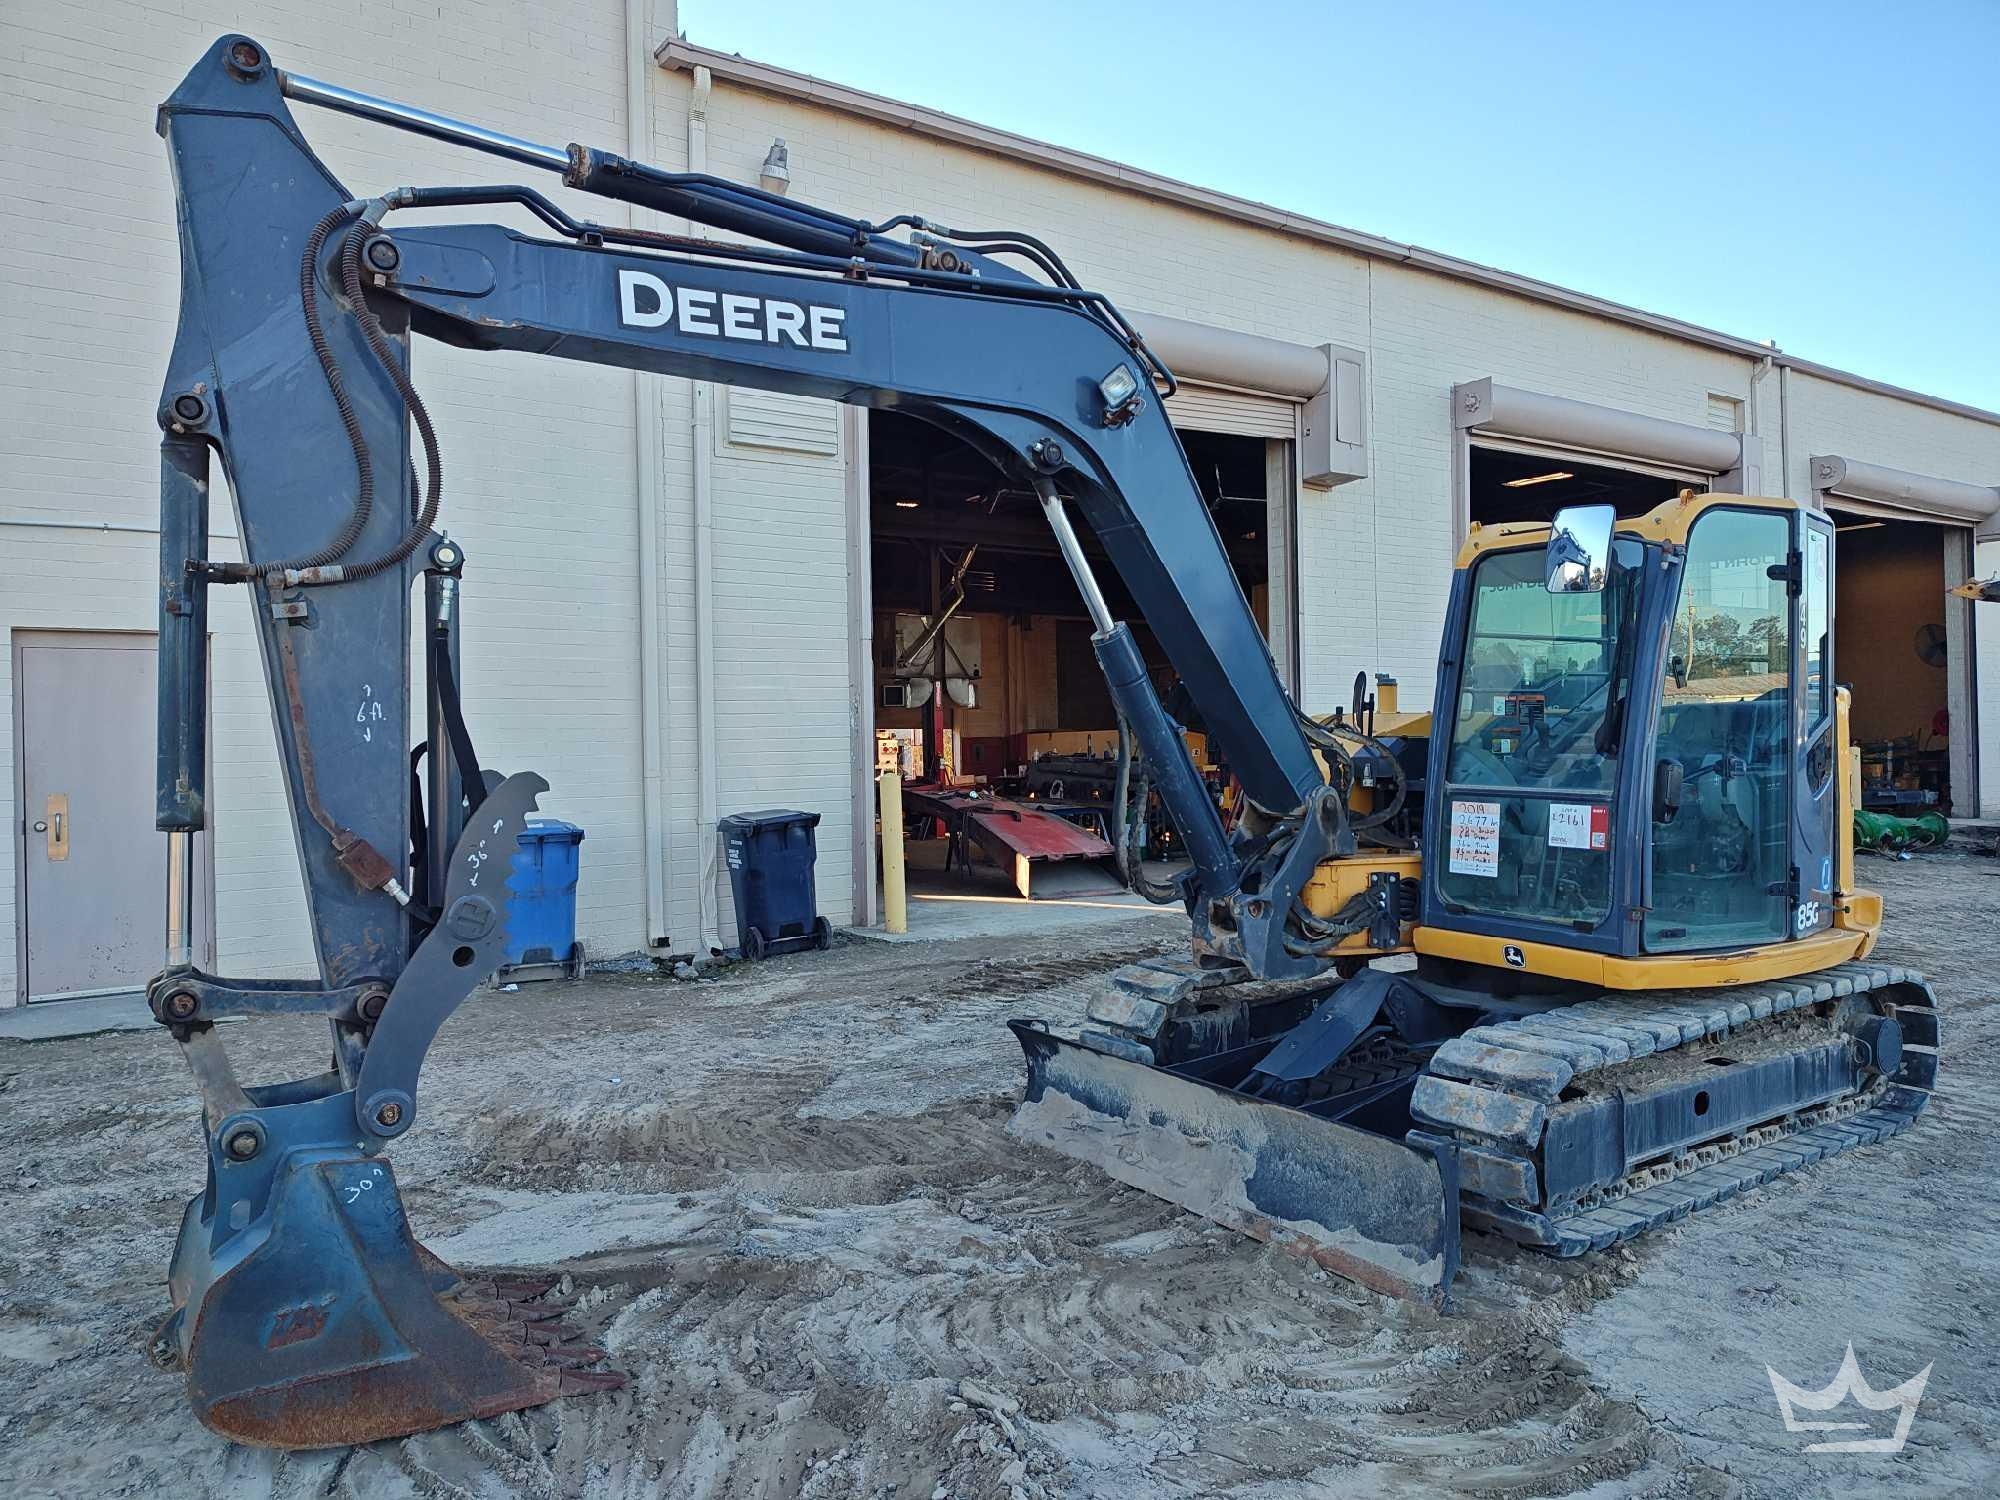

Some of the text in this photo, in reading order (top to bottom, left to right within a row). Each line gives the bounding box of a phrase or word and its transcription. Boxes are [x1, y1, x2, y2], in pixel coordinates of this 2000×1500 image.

[618, 269, 847, 351] DEERE
[357, 701, 366, 722] 6
[1459, 803, 1486, 815] 2019
[1459, 814, 1488, 828] 2677
[1797, 901, 1819, 930] 85G
